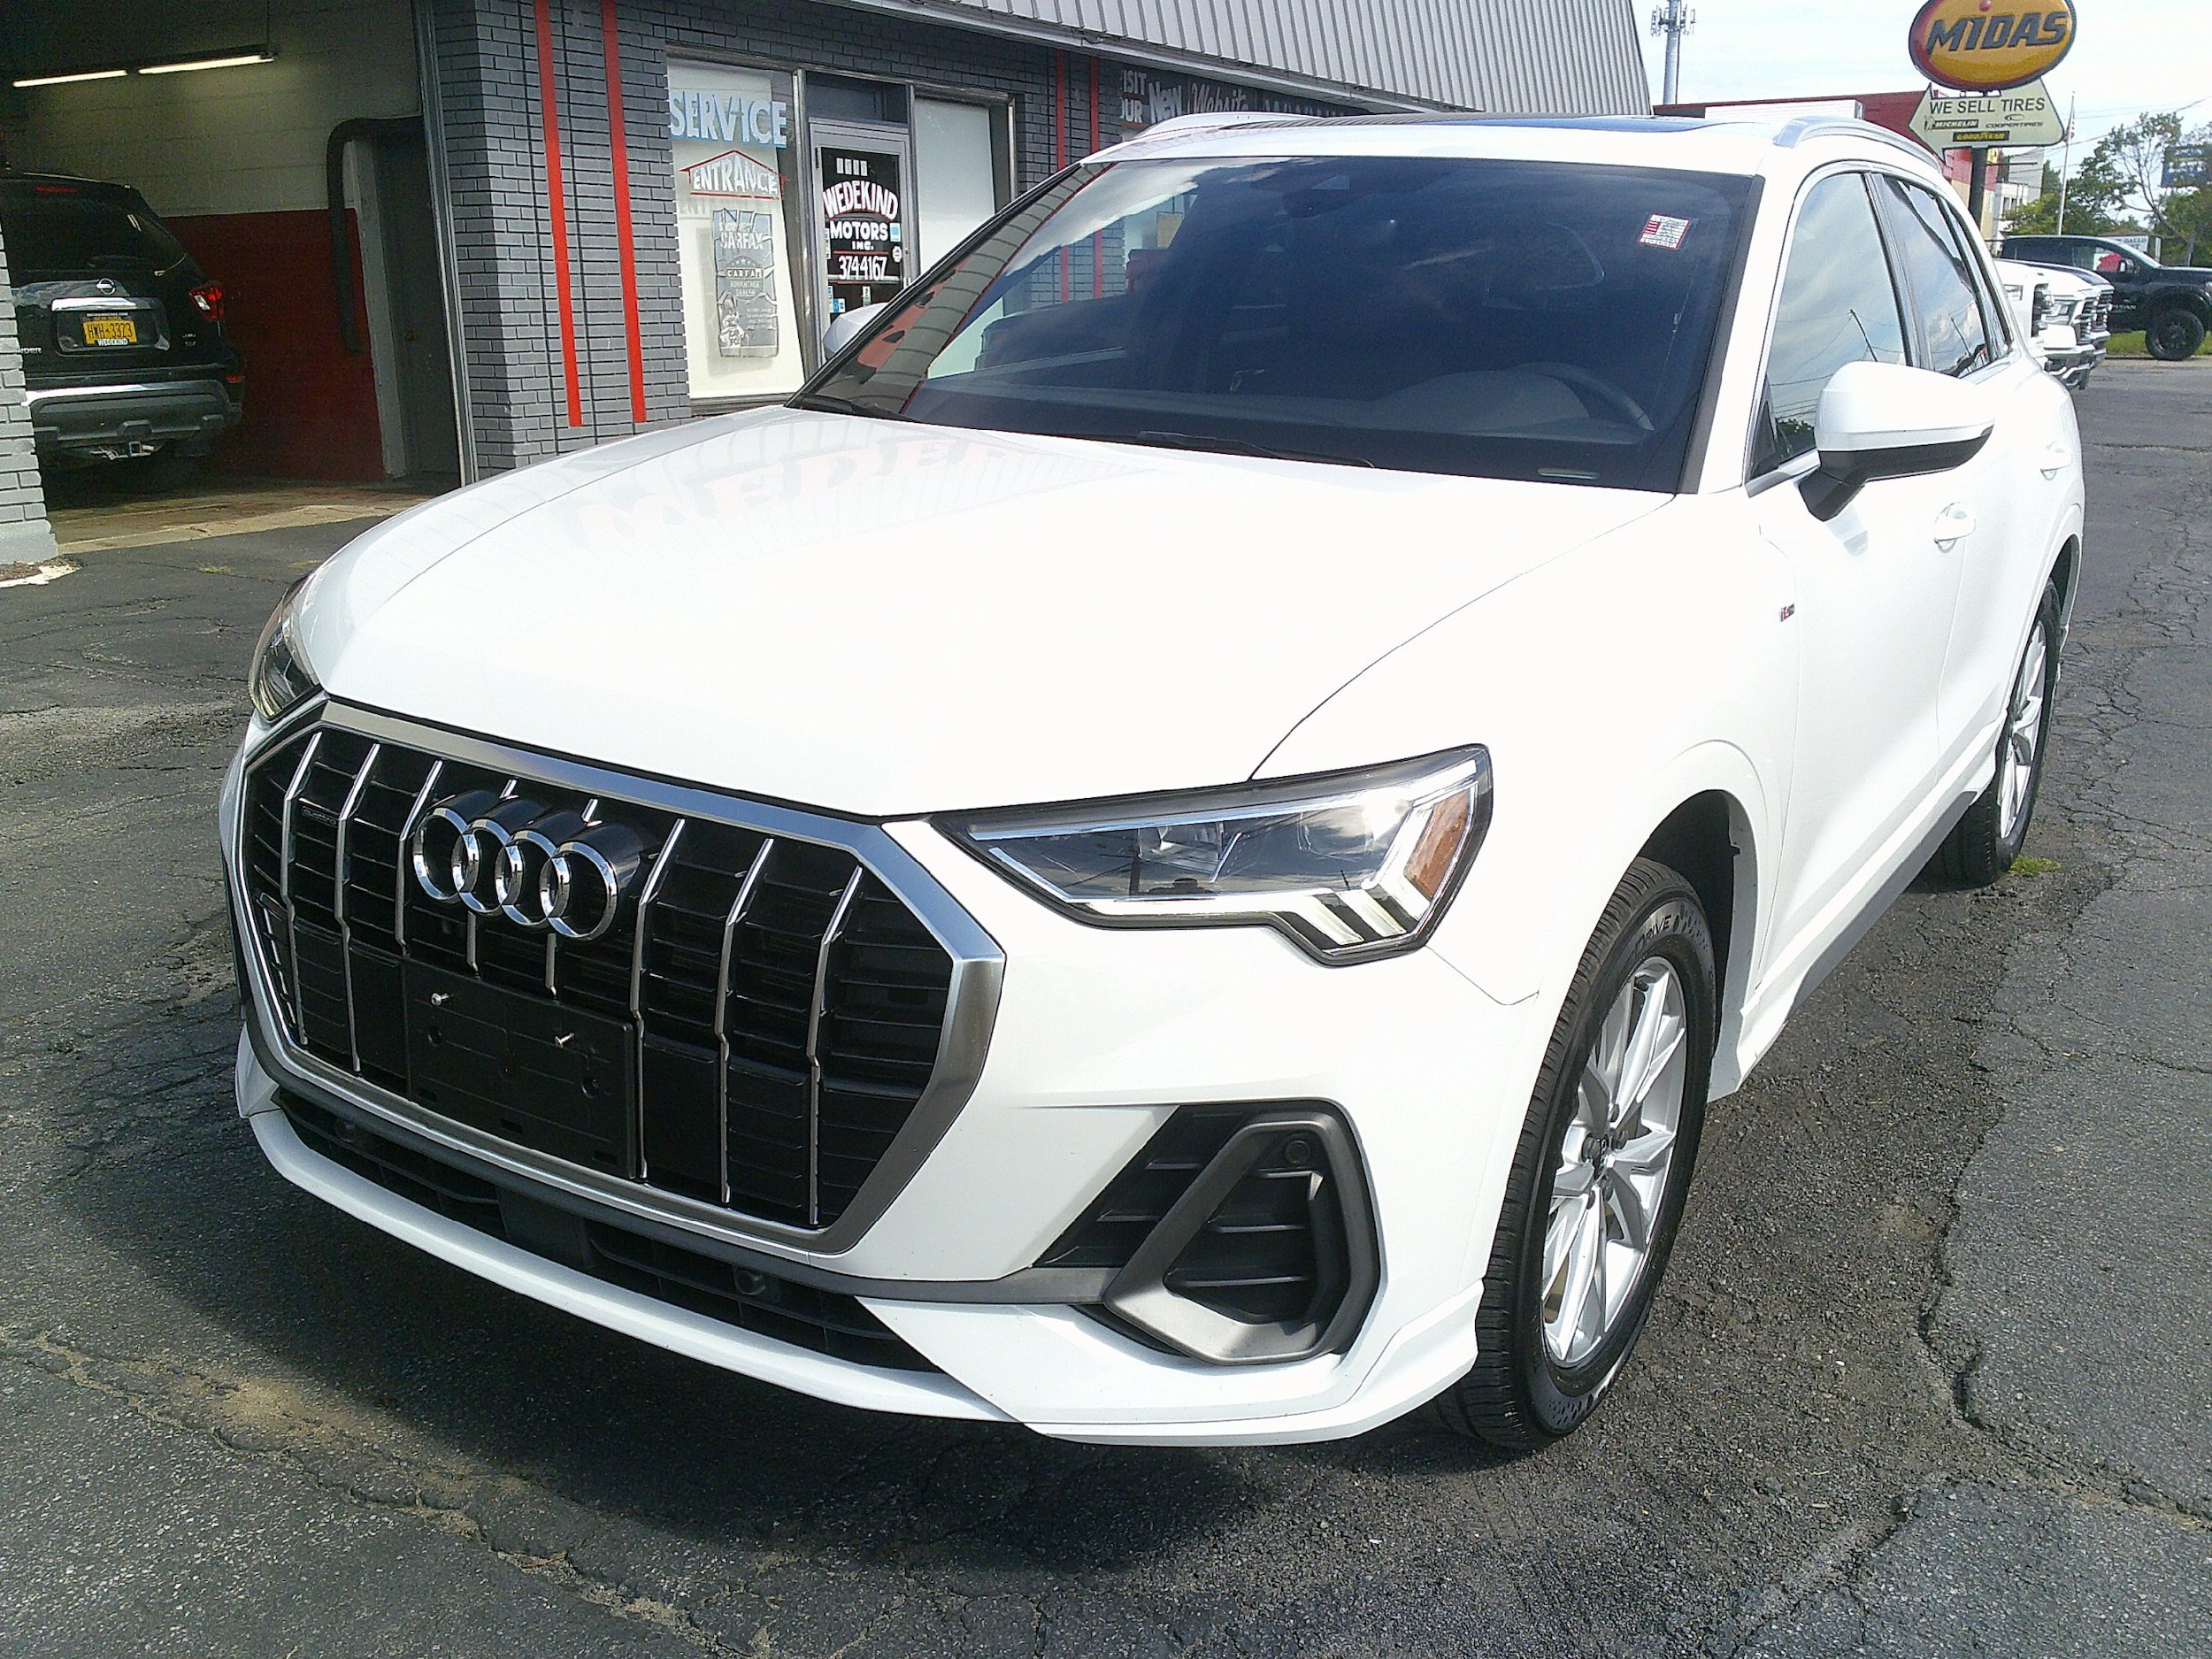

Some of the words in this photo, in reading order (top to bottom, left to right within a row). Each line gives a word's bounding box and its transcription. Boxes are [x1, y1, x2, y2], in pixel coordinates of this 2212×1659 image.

[1926, 11, 2069, 56] MIDAS
[1929, 101, 1953, 114] WE
[1957, 99, 1995, 113] SELL
[2001, 97, 2046, 112] TIRES
[670, 90, 787, 149] SERVICE
[1934, 119, 1978, 128] MICHELIN
[693, 155, 779, 195] ENTRANCE
[823, 180, 899, 221] WEDEKIND
[720, 231, 764, 250] CARFAX
[829, 220, 889, 242] MOTORS
[851, 241, 874, 251] INC.
